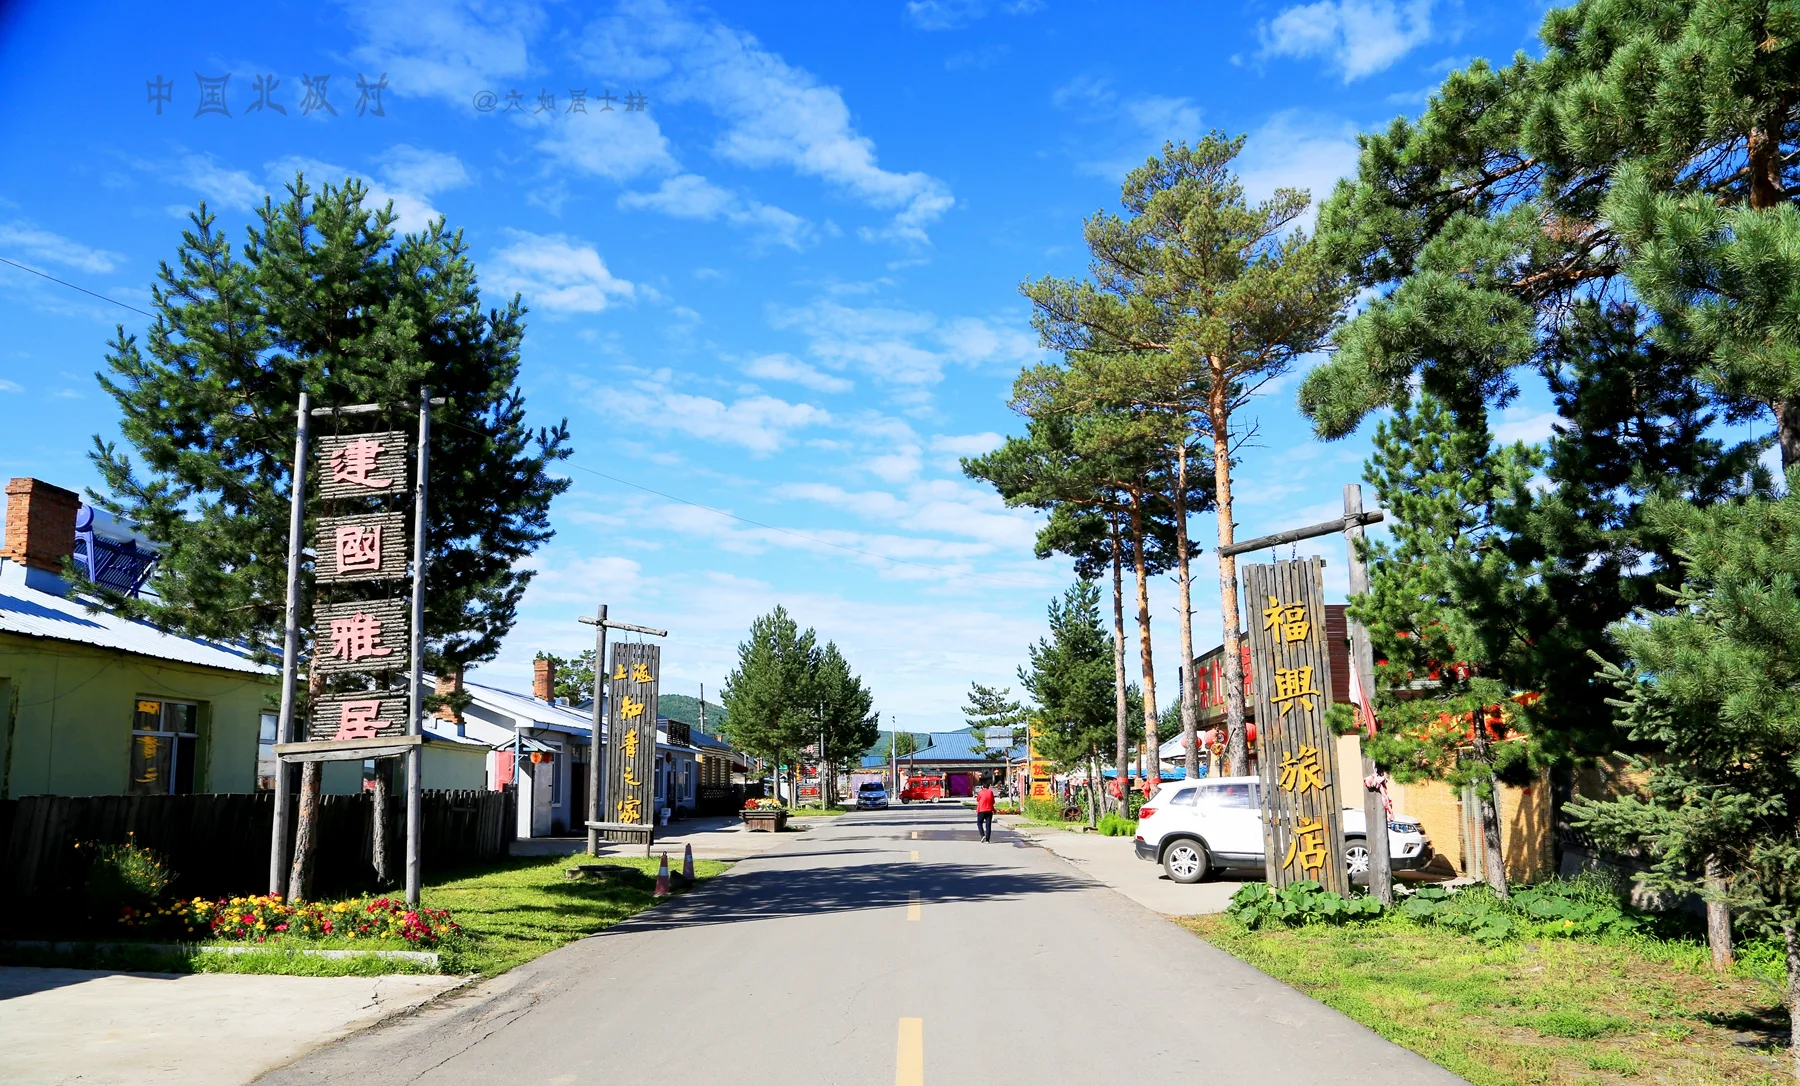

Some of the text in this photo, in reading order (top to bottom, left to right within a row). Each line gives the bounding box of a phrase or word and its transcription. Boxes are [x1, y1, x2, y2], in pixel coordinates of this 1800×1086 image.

[330, 438, 393, 741] 建國雅居
[613, 663, 654, 684] 上海
[617, 696, 645, 824] 知青之家
[1263, 596, 1331, 871] 福興旅店
